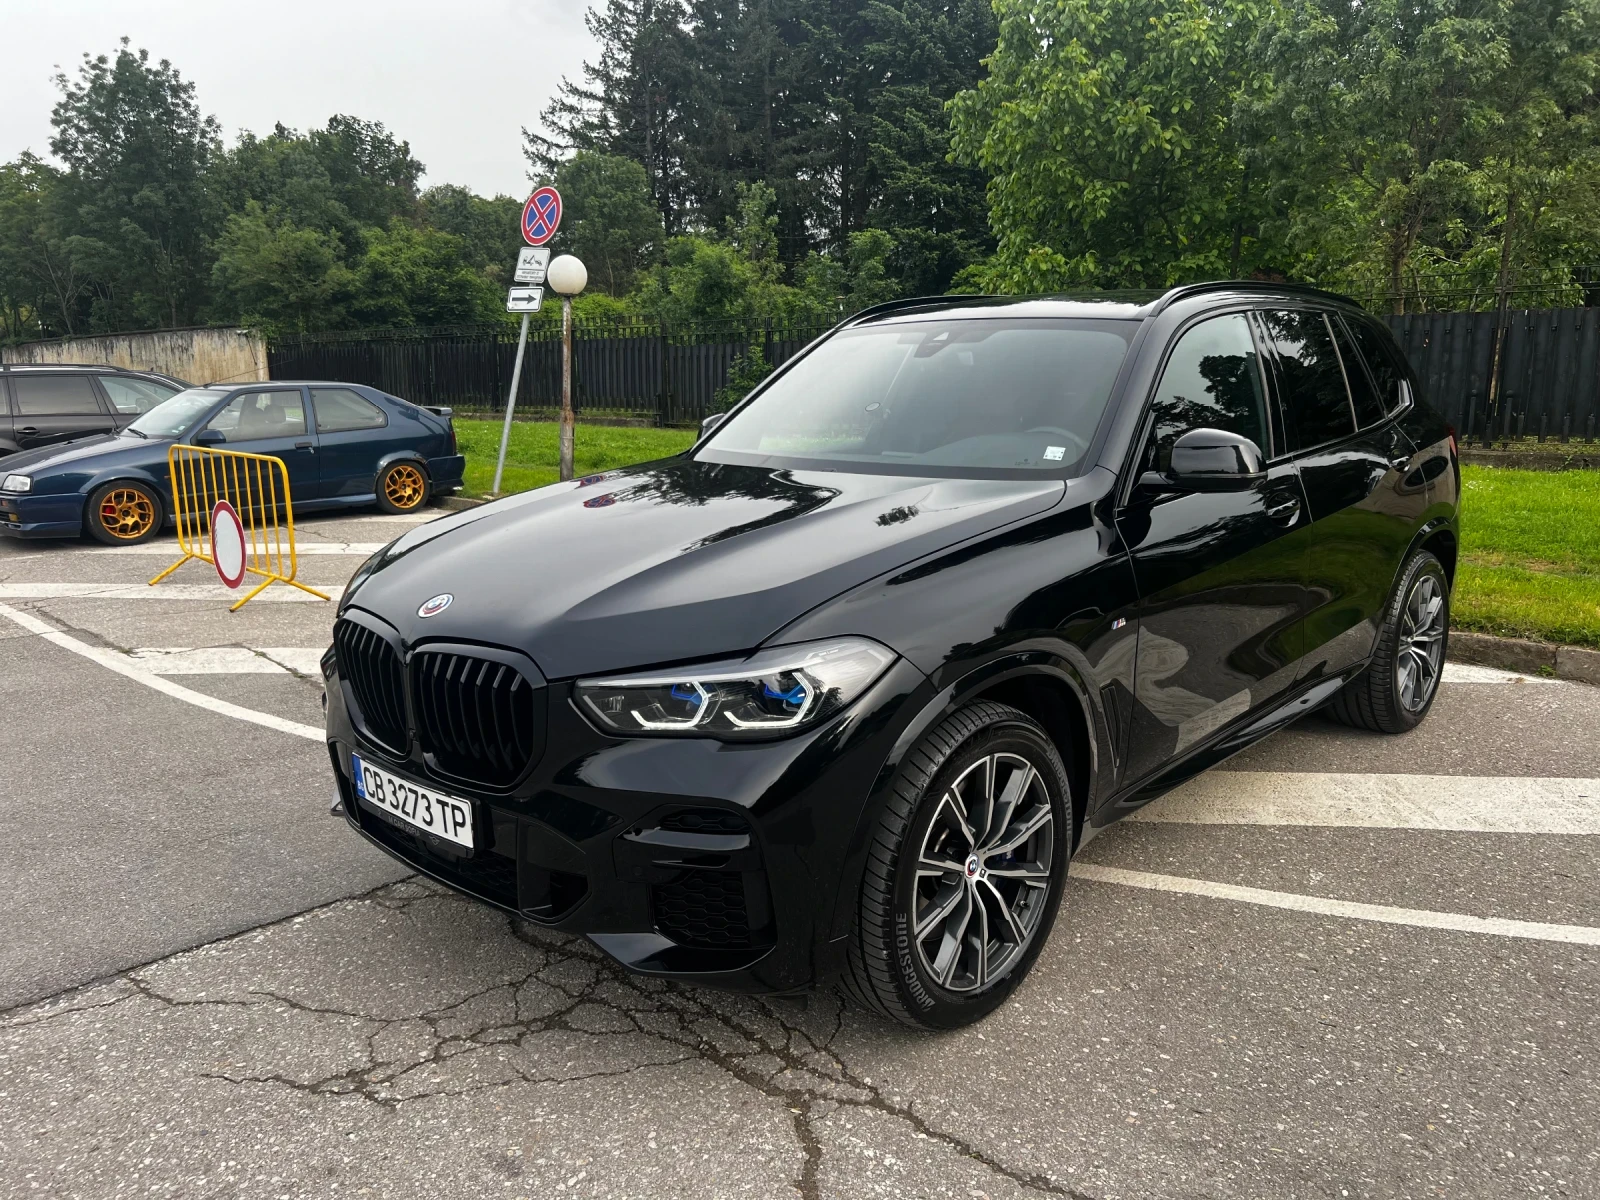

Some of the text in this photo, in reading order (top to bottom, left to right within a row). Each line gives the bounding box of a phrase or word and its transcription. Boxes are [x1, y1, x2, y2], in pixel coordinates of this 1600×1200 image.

[363, 766, 466, 838] CB 3273 TP
[895, 912, 936, 1012] BRIDGESTONE
